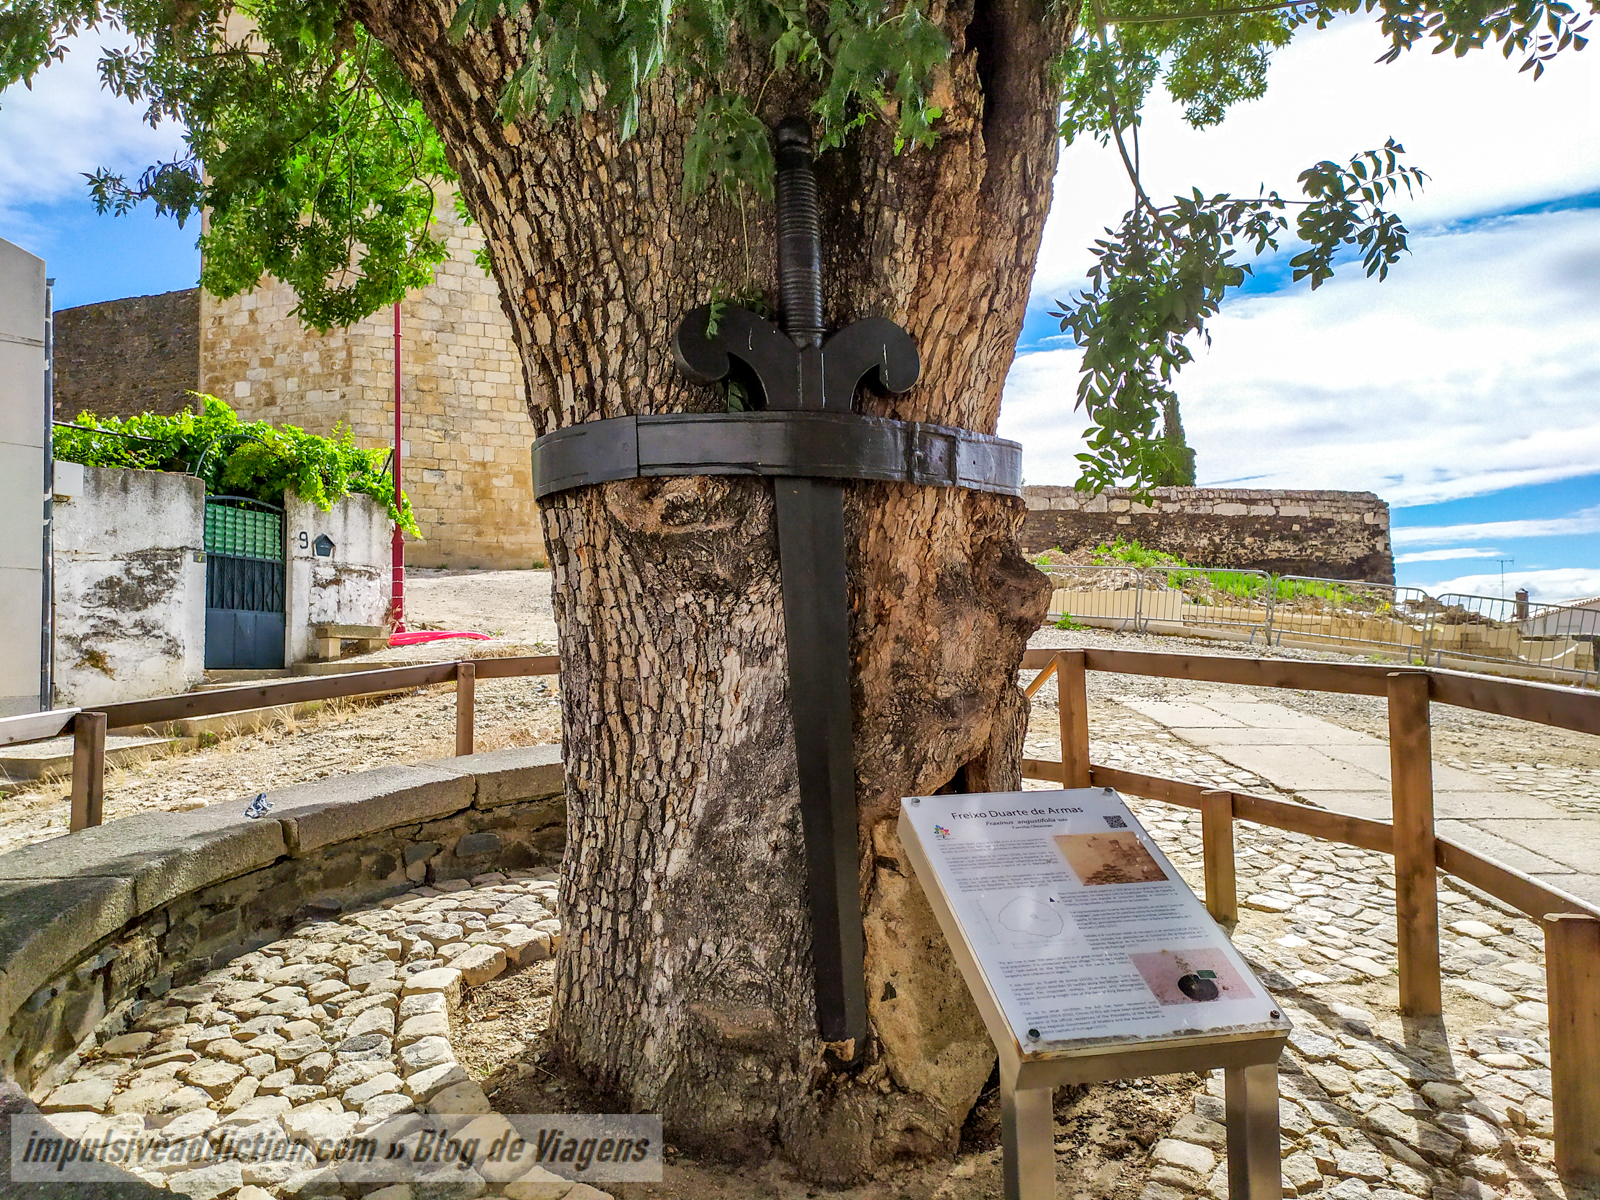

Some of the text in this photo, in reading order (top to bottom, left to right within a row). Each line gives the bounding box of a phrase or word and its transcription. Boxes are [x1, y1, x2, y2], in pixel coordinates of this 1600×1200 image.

[299, 531, 309, 549] 9
[951, 806, 1084, 820] Freixo Duarte de Armas
[1017, 817, 1056, 825] angustifolia
